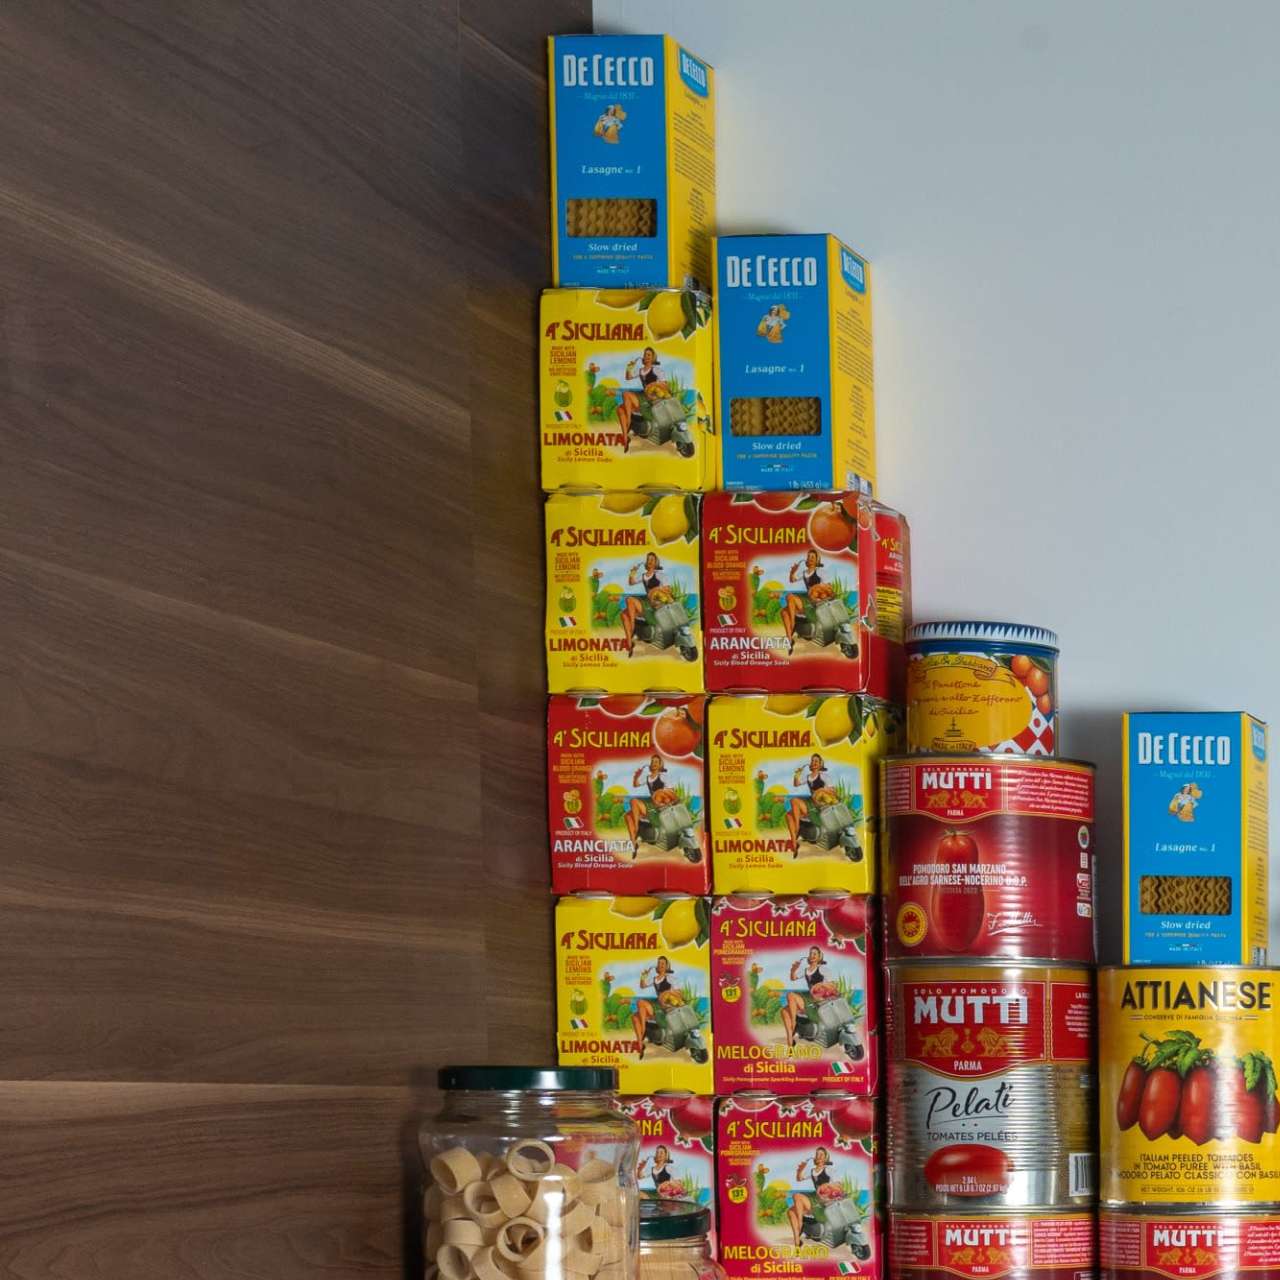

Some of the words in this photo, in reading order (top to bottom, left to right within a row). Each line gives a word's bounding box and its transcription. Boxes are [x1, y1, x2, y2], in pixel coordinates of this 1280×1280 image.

[592, 54, 654, 87] CECCO
[581, 165, 623, 176] Lasagne
[588, 243, 609, 251] Slow
[612, 243, 638, 251] dried
[756, 255, 817, 287] CECCO
[745, 364, 786, 375] Lasagne
[543, 432, 626, 446] LIMONATA
[752, 442, 773, 450] Slow
[776, 442, 801, 450] dried
[549, 638, 631, 652] LIMONATA
[710, 637, 792, 650] ARANCIATA
[1168, 733, 1231, 765] CECCO
[922, 772, 992, 790] MUTTI
[554, 840, 634, 853] ARANCIATA
[715, 839, 794, 853] LIMONATA
[1156, 843, 1197, 854] Lasagne
[584, 854, 614, 862] Sicilia
[913, 864, 950, 874] POMODORO
[951, 864, 968, 874] SAN
[969, 863, 1007, 874] MARZANO
[1161, 920, 1183, 929] Slow
[1185, 920, 1211, 929] dried
[1120, 981, 1272, 1010] ATTIANESE
[913, 996, 1028, 1024] MUTTI
[561, 1040, 641, 1053] LIMONATA
[717, 1046, 822, 1060] MELOGRANO
[756, 1061, 796, 1073] Sicilia
[954, 1061, 982, 1071] PARMA
[924, 1082, 1016, 1130] Pelati
[927, 1132, 974, 1141] TOMATES
[1172, 1154, 1203, 1162] PEELED
[1143, 1163, 1176, 1171] TOMATO
[1150, 1171, 1181, 1180] PELATO
[724, 1245, 829, 1260] MELOGRANO
[763, 1261, 803, 1273] Sicilia
